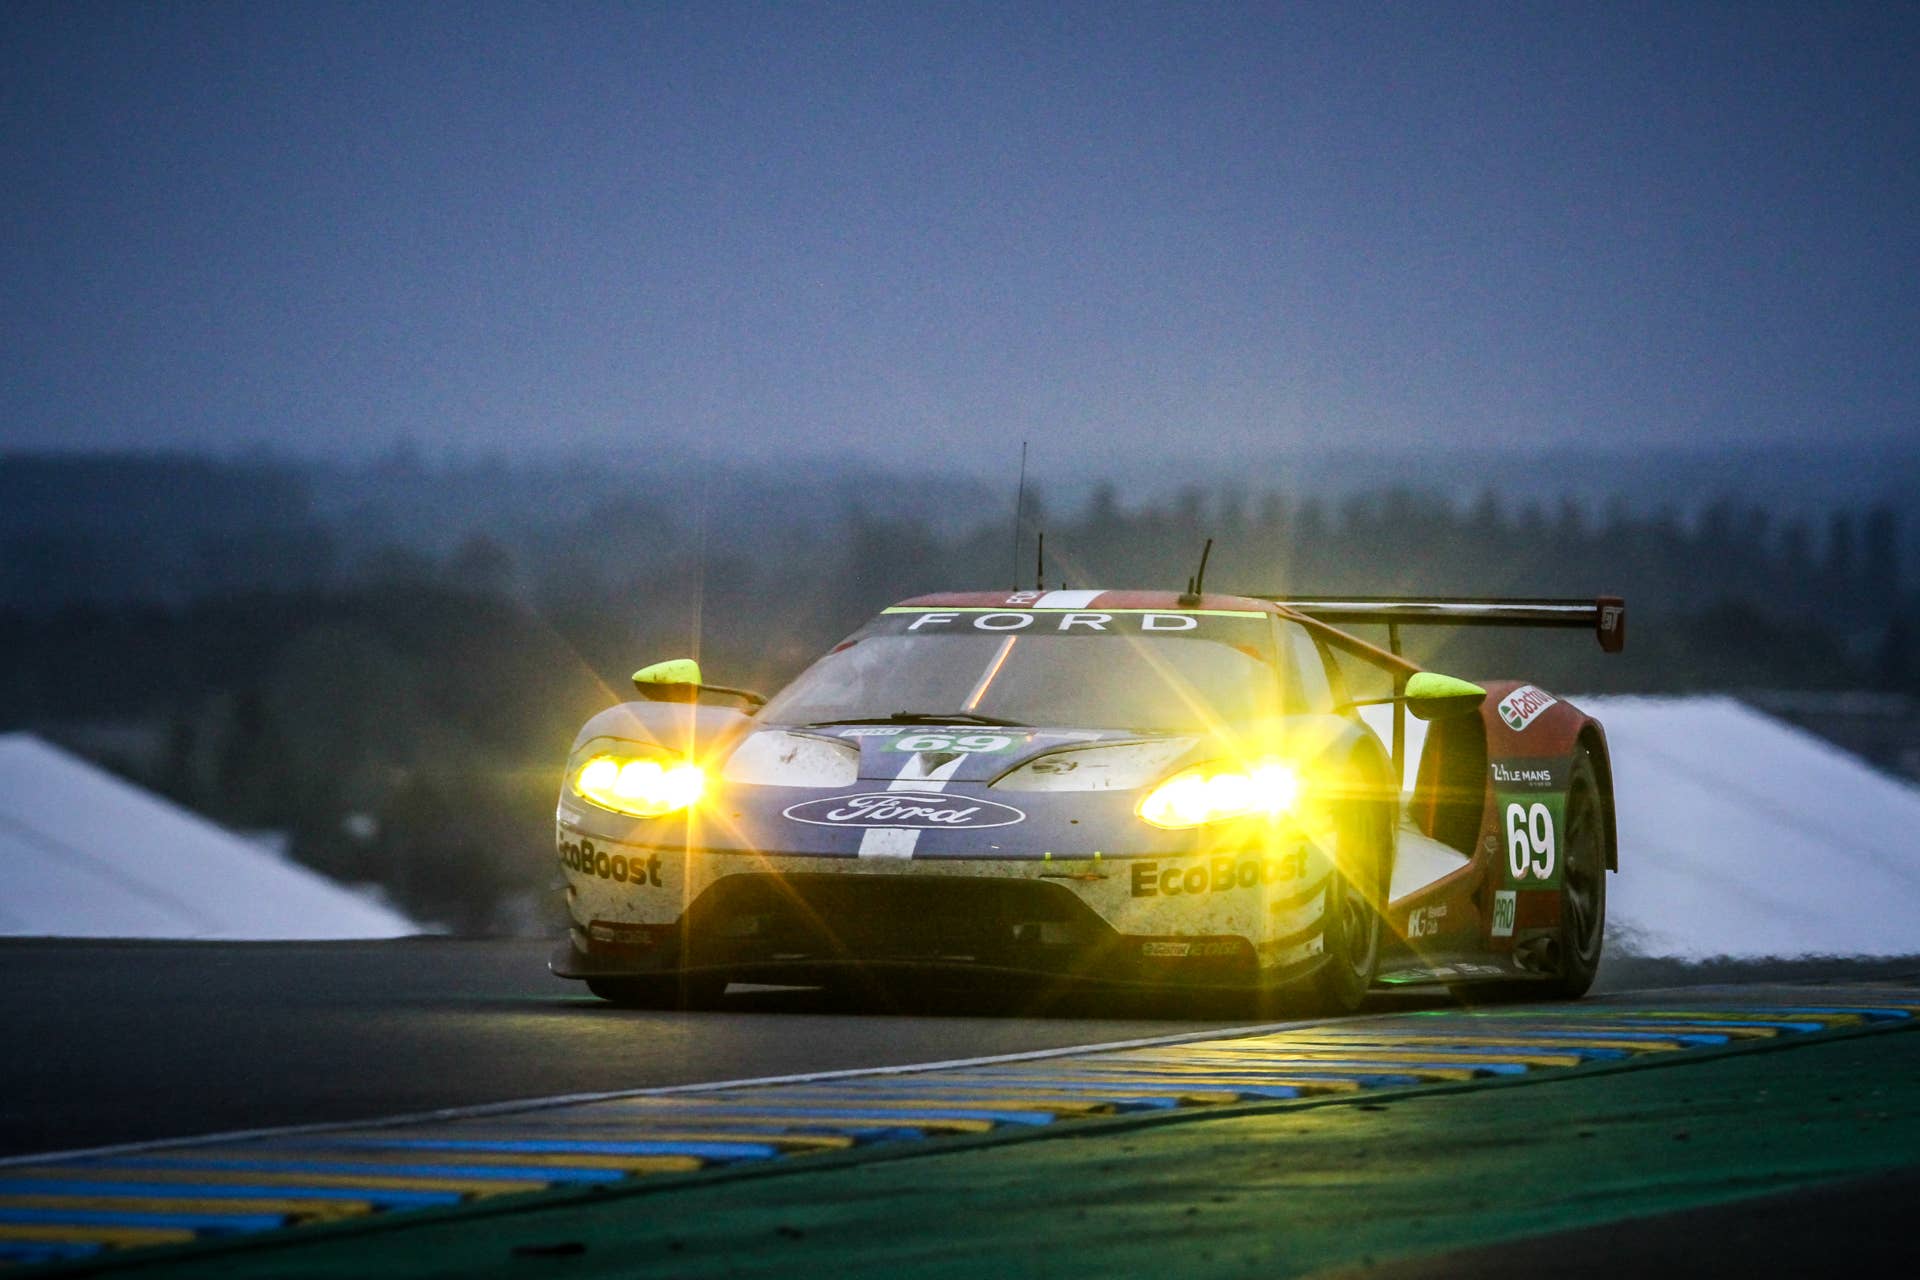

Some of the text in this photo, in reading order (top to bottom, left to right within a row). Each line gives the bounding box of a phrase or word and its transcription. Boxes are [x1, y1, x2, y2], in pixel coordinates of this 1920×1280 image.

[908, 612, 1198, 631] FORD
[895, 734, 1012, 752] 69
[1510, 770, 1522, 781] LE
[1522, 770, 1552, 781] MANS
[826, 796, 981, 824] Ford
[1506, 802, 1556, 880] 69
[1493, 898, 1515, 930] PRO
